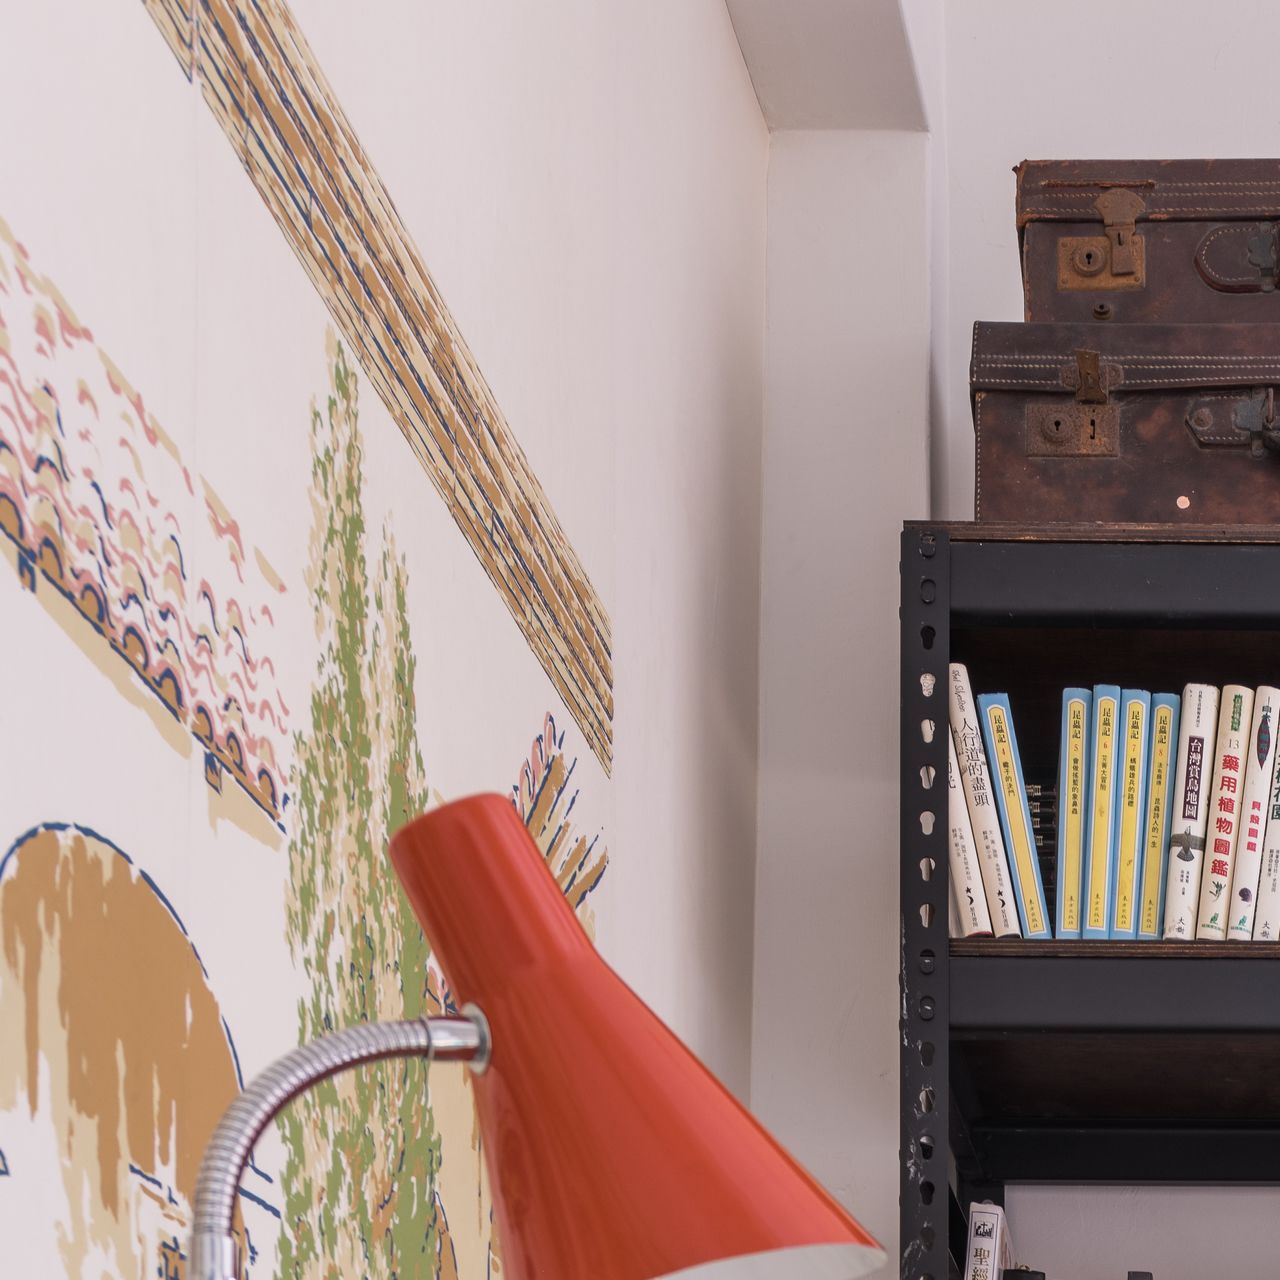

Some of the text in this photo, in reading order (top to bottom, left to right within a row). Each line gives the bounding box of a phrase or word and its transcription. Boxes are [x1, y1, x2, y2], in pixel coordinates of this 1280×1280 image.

[993, 715, 1007, 744] 昆蟲記
[1071, 710, 1081, 739] 昆蟲記
[1101, 708, 1111, 737] 昆蟲記
[1129, 711, 1140, 740] 昆蟲記
[1157, 716, 1168, 745] 昆蟲記
[1226, 738, 1239, 750] 13
[961, 717, 990, 807] 人行道的盡頭
[1184, 738, 1203, 820] 台灣賞鳥地圖
[1211, 754, 1240, 877] 藥用植物圖鑑
